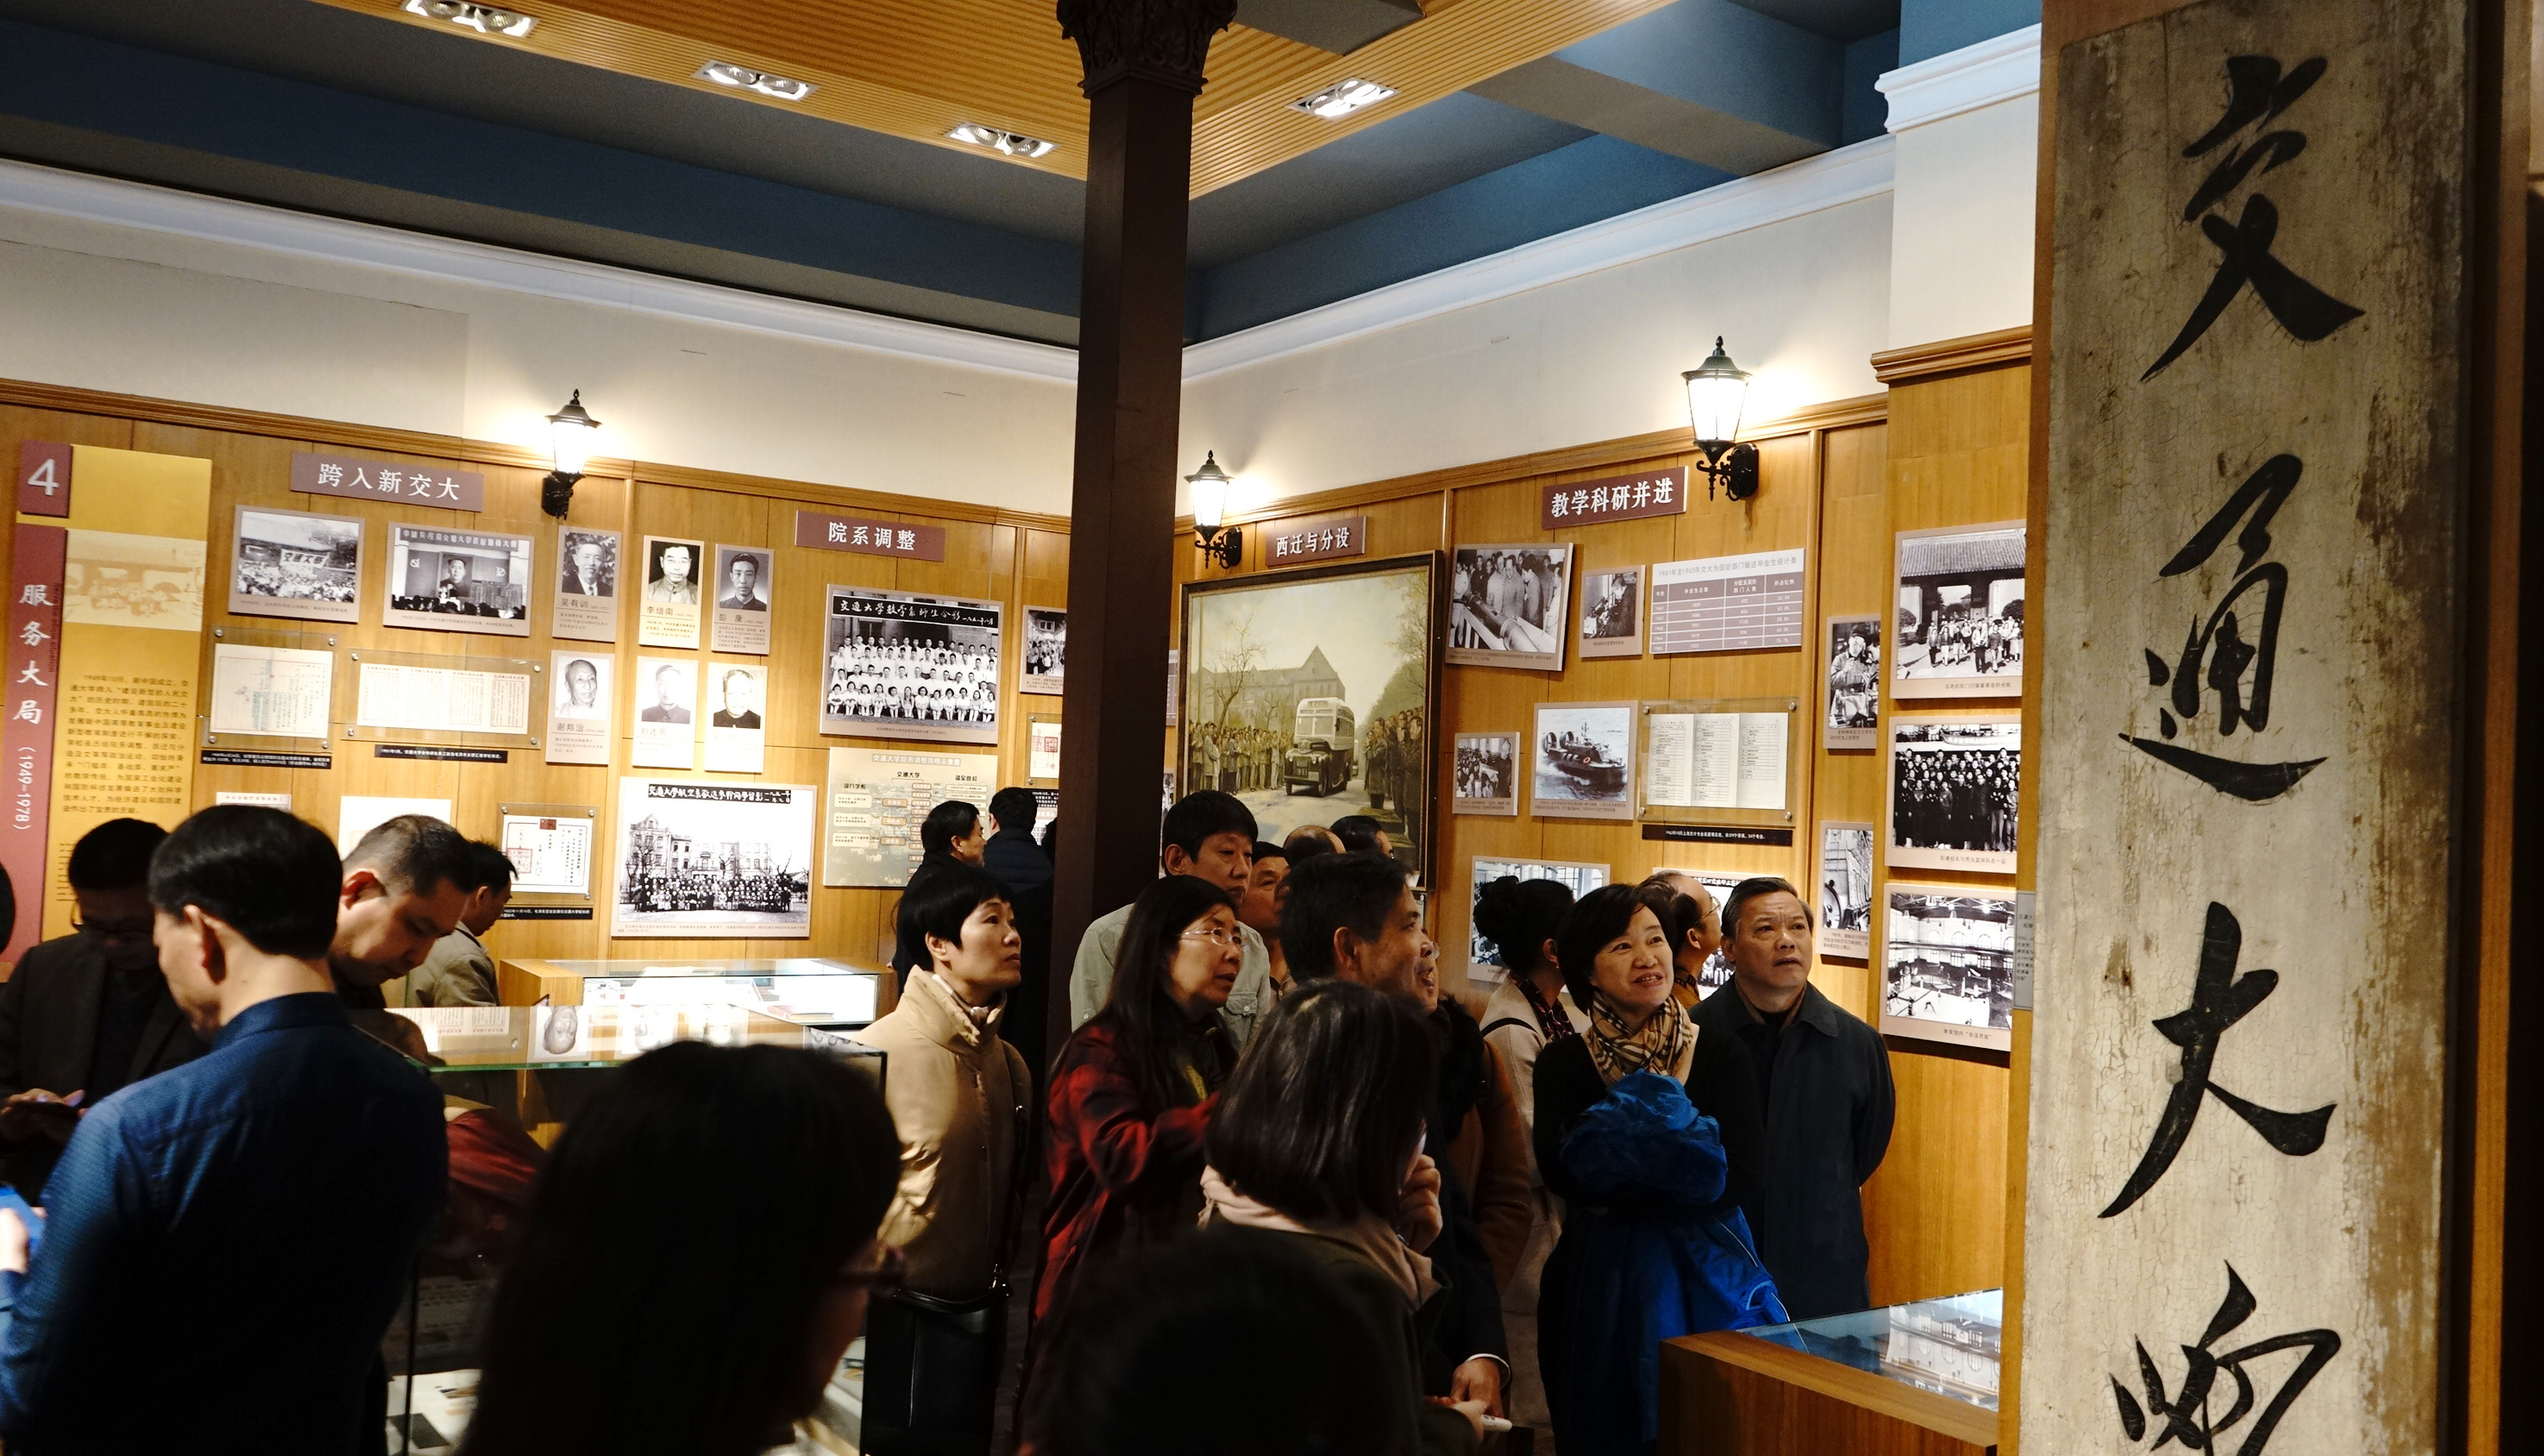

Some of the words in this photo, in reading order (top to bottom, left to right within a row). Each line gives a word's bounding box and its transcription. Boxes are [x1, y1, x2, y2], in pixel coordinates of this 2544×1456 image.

[28, 459, 60, 496] 4
[317, 462, 461, 501] 跨入新交大
[1551, 477, 1674, 518] 教学科研并进
[828, 521, 916, 551] 院系调整
[1276, 526, 1350, 558] 西迁与分设
[561, 598, 588, 608] 吴有训
[646, 606, 674, 616] 李培南
[12, 584, 54, 725] 服务大局
[556, 722, 584, 732] 谢邦治
